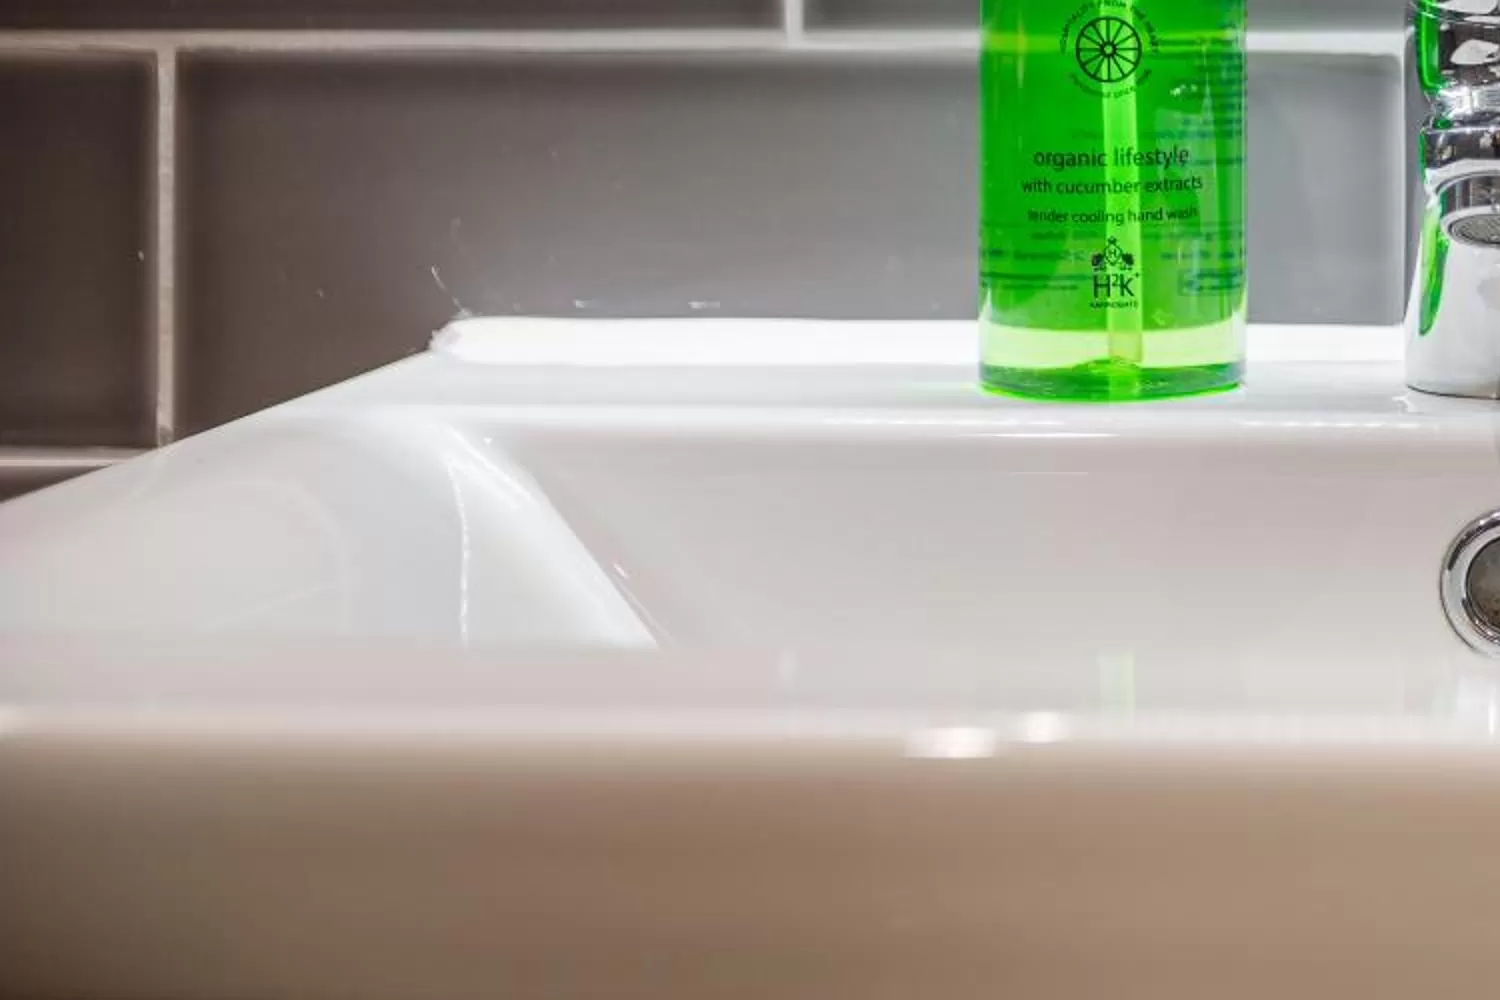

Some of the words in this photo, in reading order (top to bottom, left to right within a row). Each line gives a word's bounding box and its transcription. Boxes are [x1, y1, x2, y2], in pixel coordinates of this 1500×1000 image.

[1033, 148, 1108, 172] organic
[1113, 145, 1189, 169] lifestyle
[1022, 177, 1052, 193] with
[1055, 180, 1141, 195] cucumber
[1144, 176, 1203, 193] extracts
[1071, 209, 1125, 226] cooling
[1128, 207, 1163, 222] hand
[1166, 206, 1199, 220] wash
